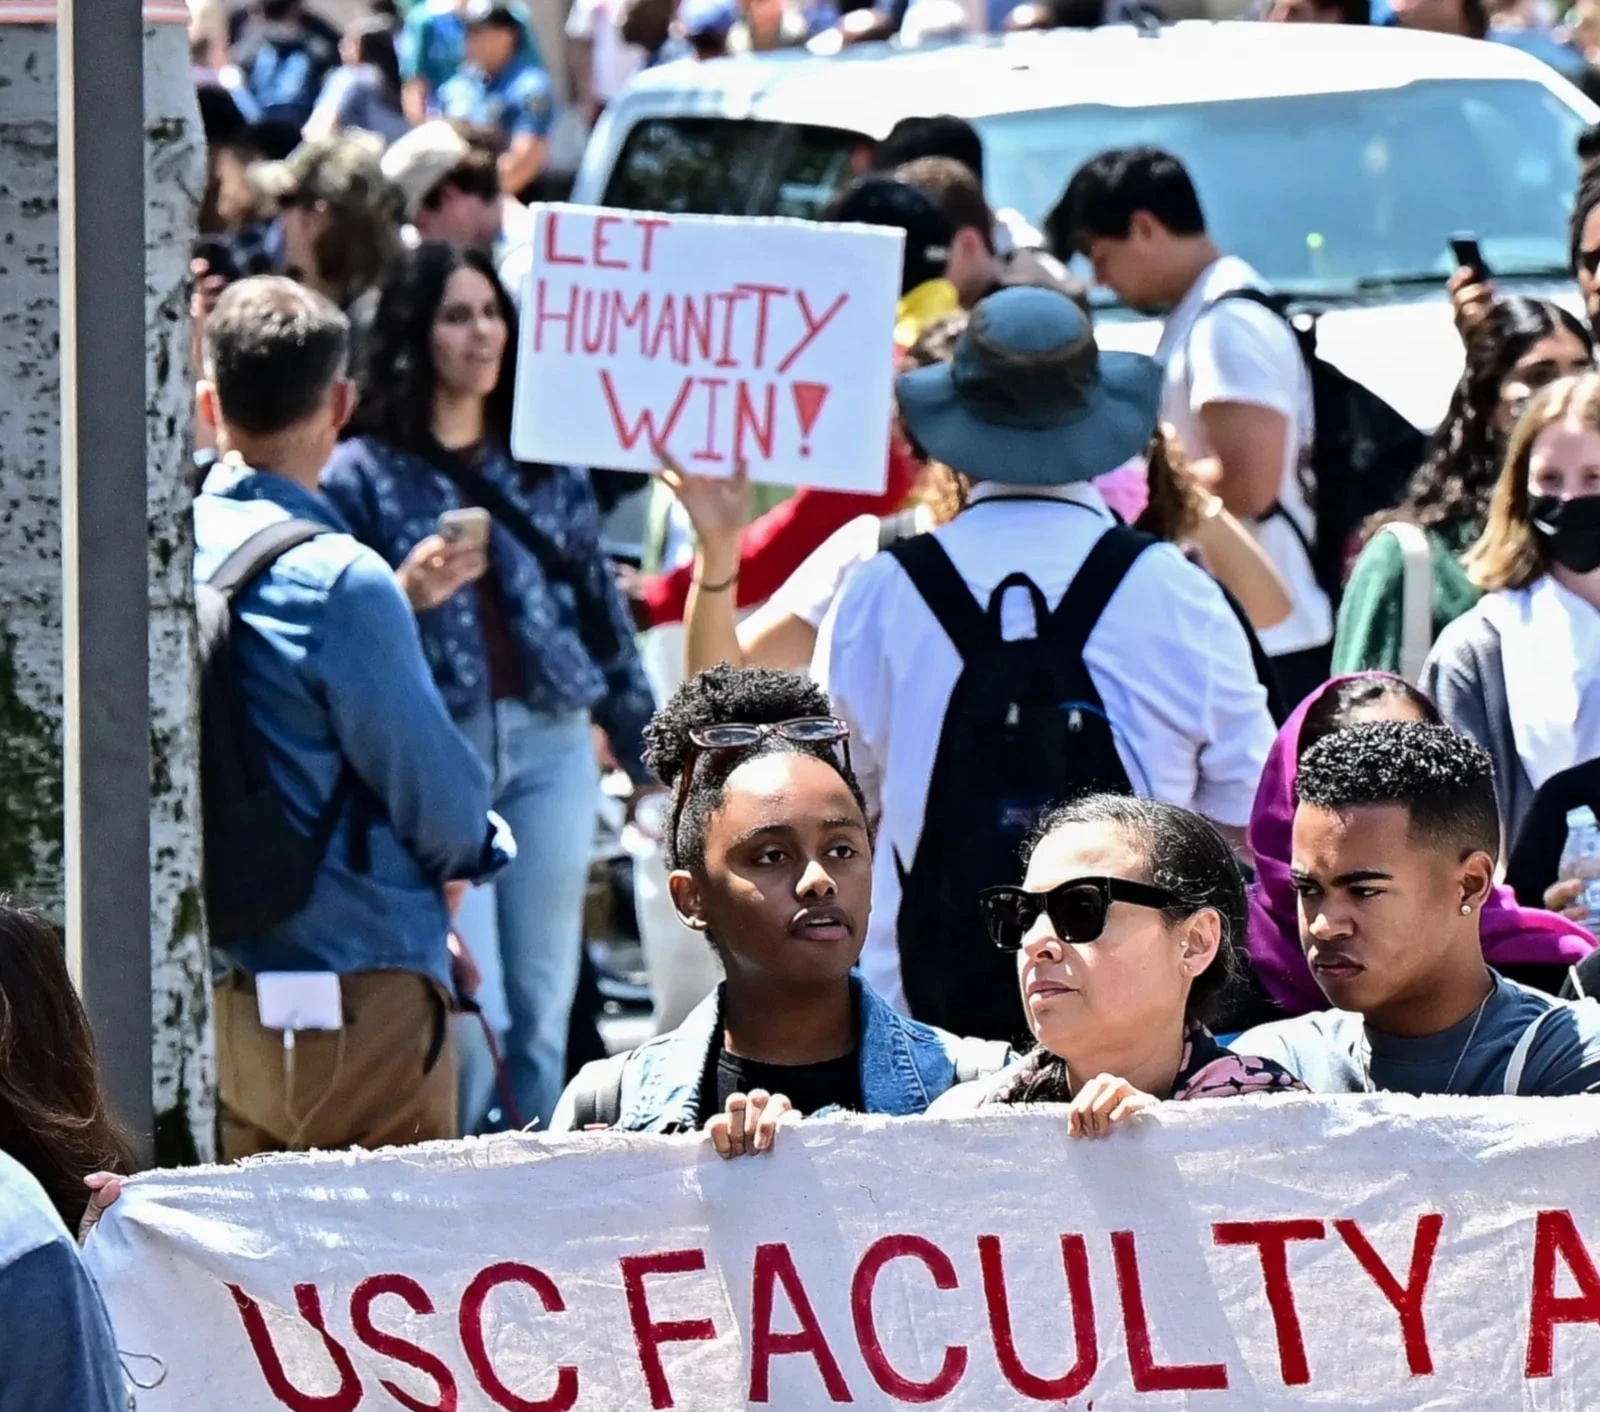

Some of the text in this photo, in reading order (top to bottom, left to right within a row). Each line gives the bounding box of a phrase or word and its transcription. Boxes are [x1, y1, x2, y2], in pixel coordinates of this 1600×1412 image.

[544, 211, 672, 273] LET
[533, 277, 850, 375] HUMANITY
[599, 368, 831, 463] WIN!
[621, 1213, 1445, 1409] FACULTY
